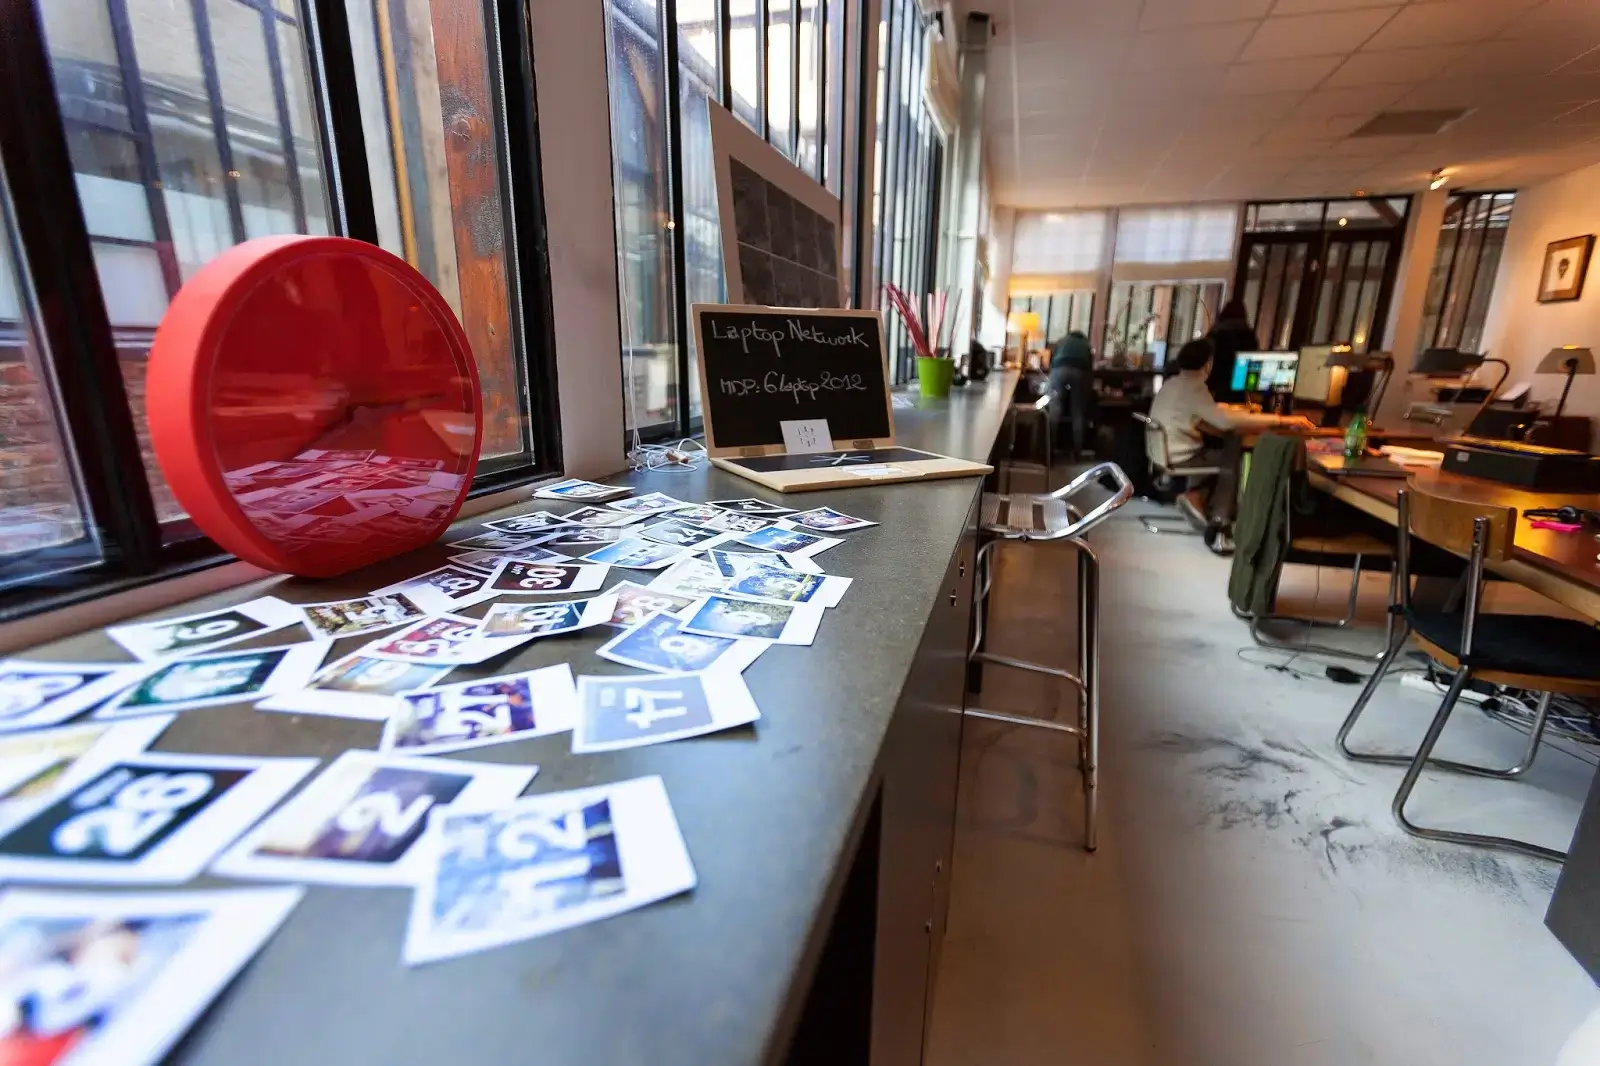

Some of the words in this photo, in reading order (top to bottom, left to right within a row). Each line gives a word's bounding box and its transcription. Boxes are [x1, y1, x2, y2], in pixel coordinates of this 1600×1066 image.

[712, 320, 785, 357] Laptop
[786, 319, 869, 348] Network
[520, 567, 567, 589] 30
[521, 606, 569, 630] 19
[625, 687, 688, 729] 17
